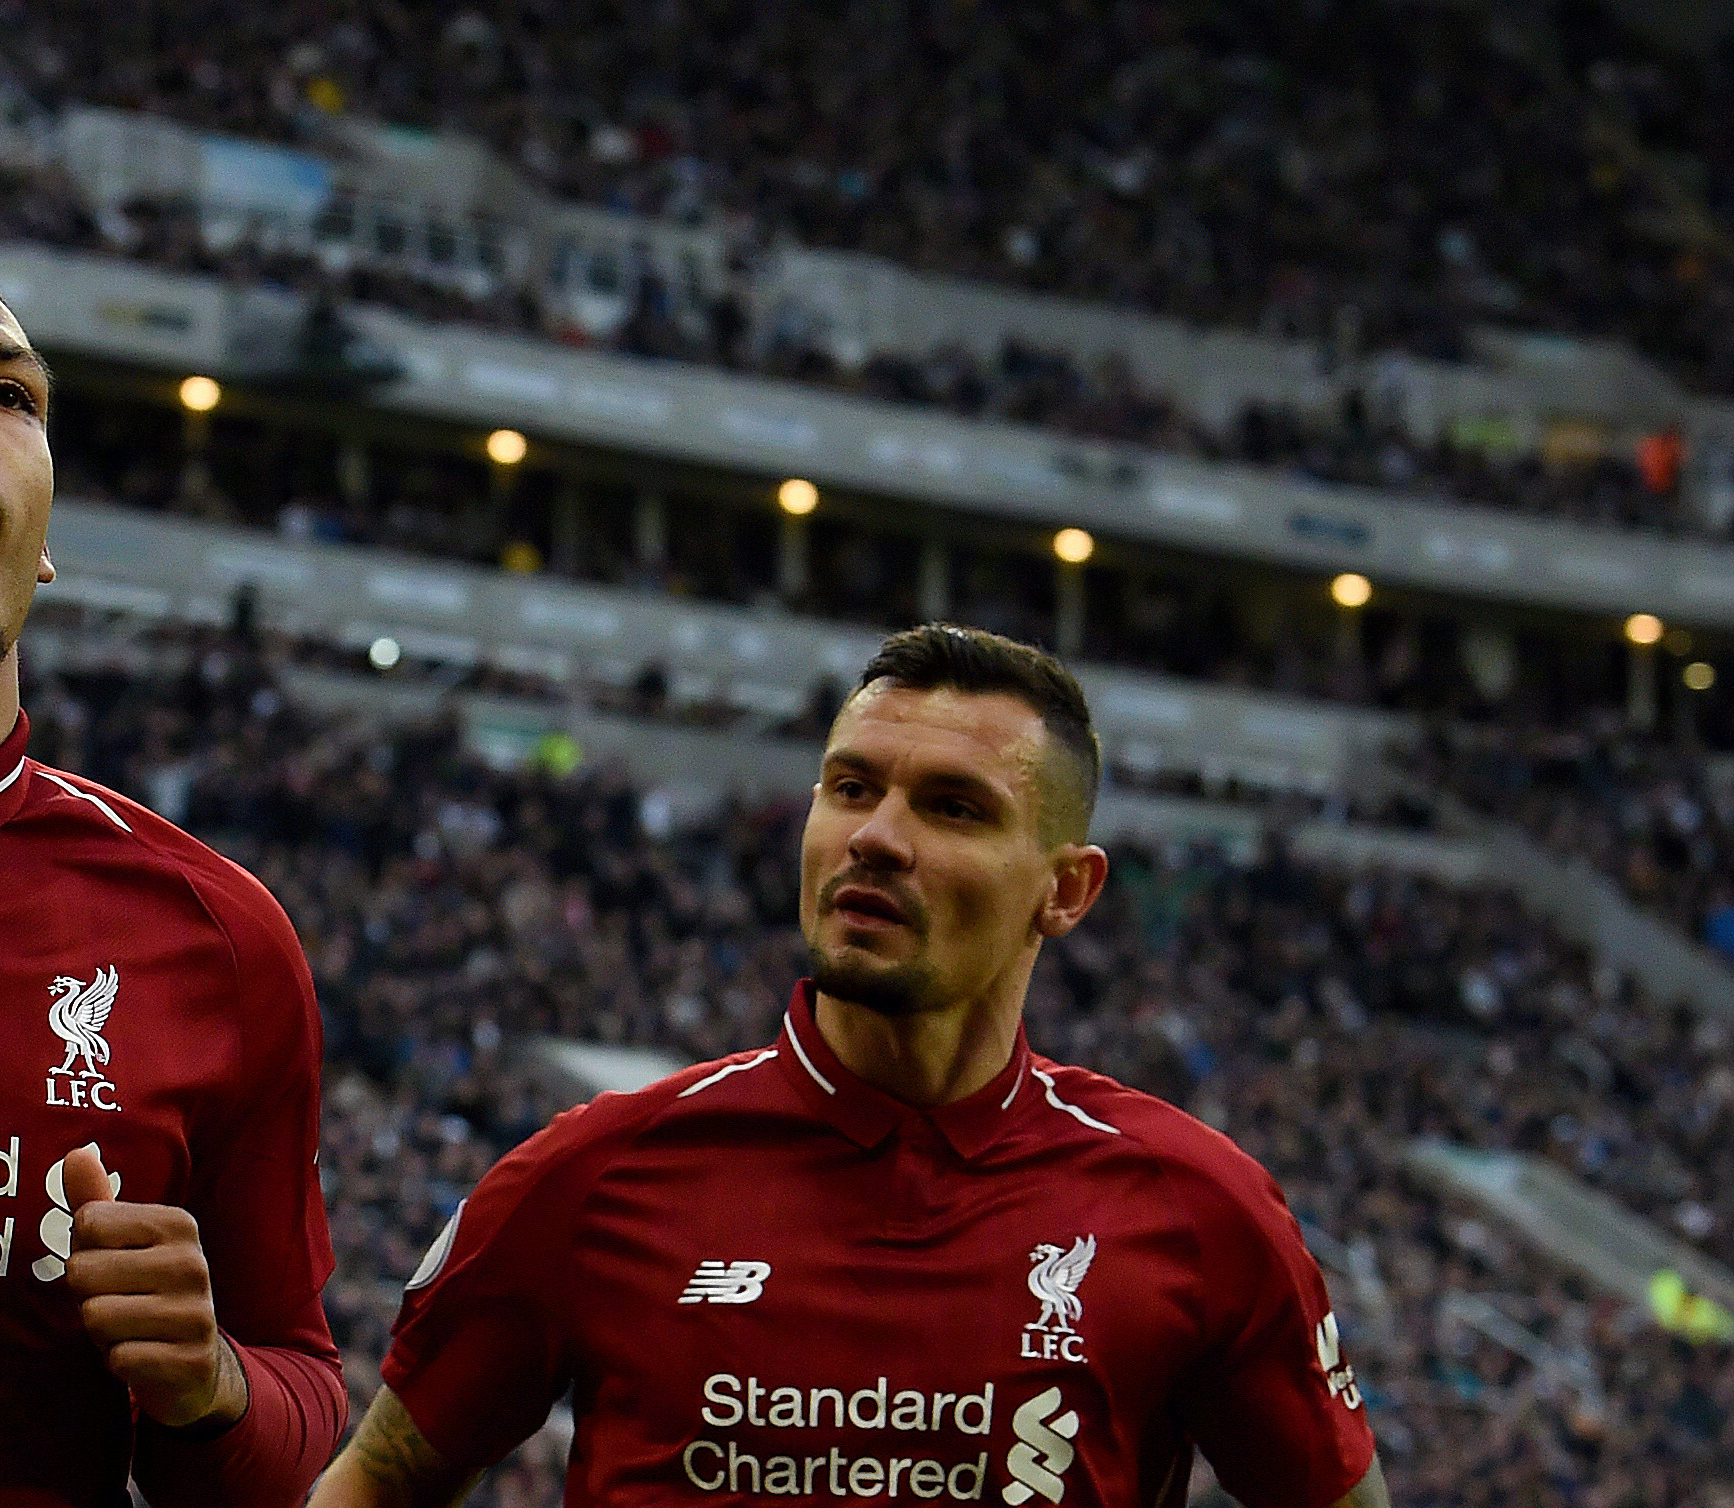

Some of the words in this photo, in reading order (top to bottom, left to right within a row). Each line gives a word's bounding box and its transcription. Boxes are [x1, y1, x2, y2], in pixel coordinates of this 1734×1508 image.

[45, 1077, 122, 1112] L.F.C.
[701, 1373, 994, 1435] Standard
[682, 1440, 988, 1500] Chartered
